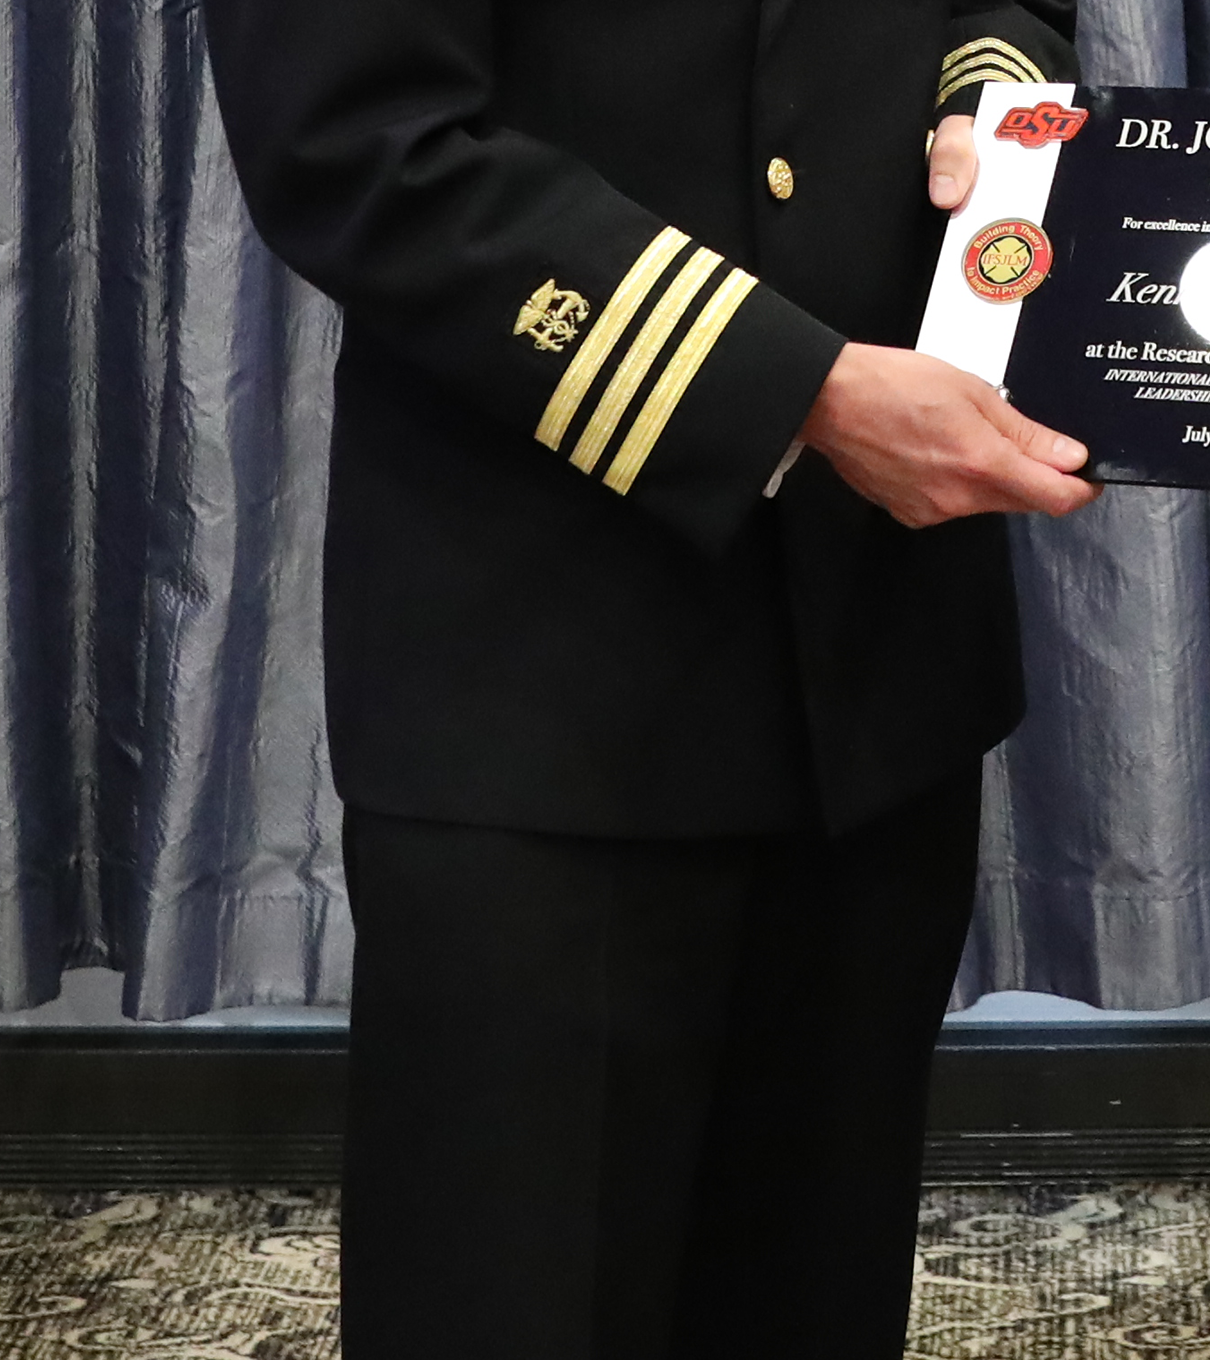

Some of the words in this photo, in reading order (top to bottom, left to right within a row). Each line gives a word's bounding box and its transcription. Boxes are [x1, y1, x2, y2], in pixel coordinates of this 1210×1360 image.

[998, 103, 1085, 143] OSU
[1115, 118, 1179, 150] DR.
[1122, 216, 1144, 229] For
[1144, 219, 1200, 232] excellence
[973, 225, 1016, 249] Building
[1020, 224, 1044, 251] Theory
[982, 253, 1028, 266] IFSJLM
[971, 276, 1000, 295] Impact
[1002, 269, 1040, 295] Practice
[1085, 343, 1103, 358] at
[1107, 340, 1138, 360] the
